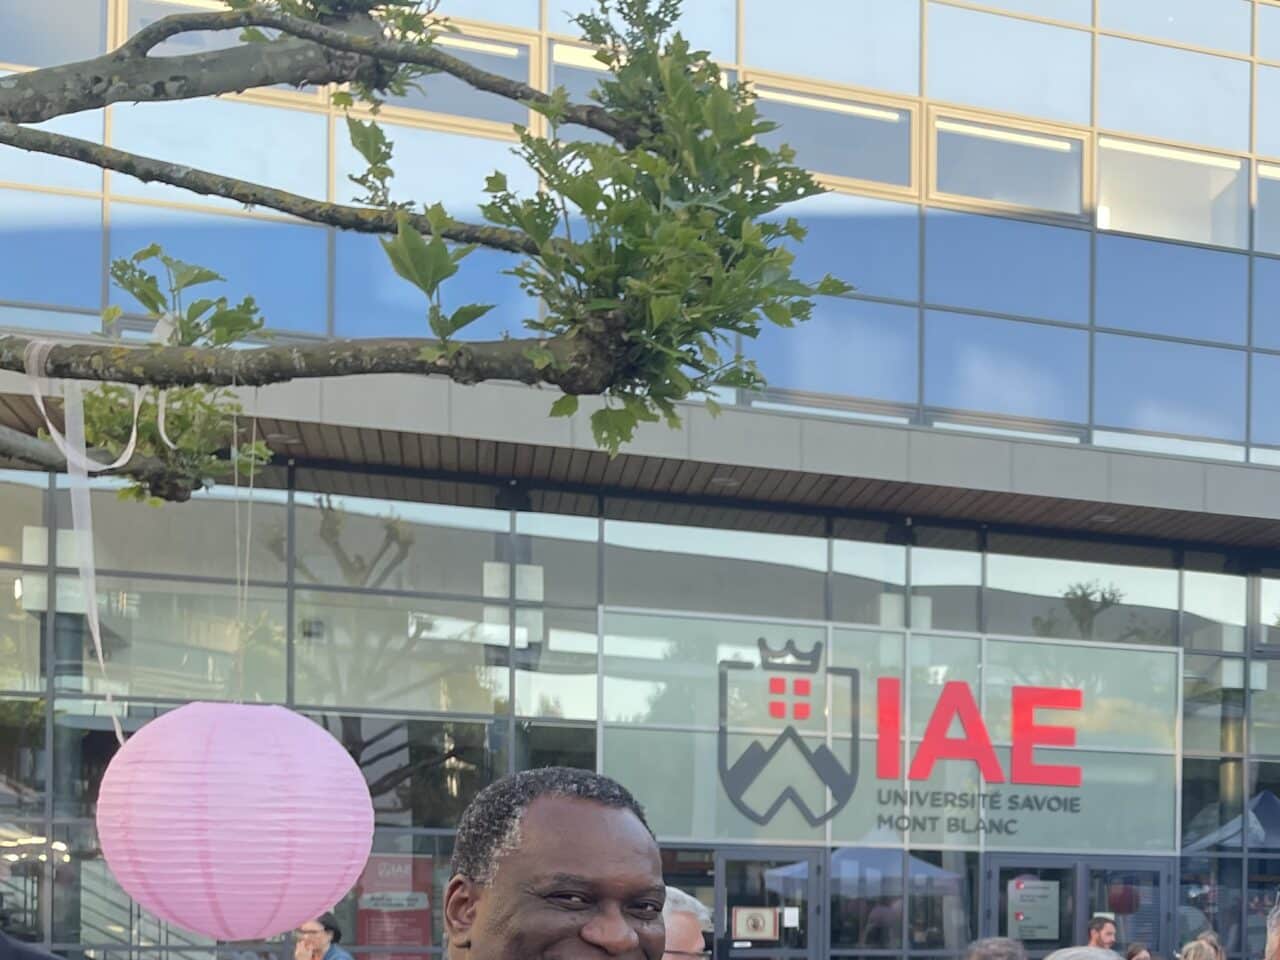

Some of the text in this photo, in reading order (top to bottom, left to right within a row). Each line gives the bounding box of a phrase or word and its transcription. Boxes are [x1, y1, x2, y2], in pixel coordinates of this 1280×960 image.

[876, 677, 1082, 787] IAE
[877, 788, 1081, 813] UNIVERSITÉ SAVOIE
[877, 814, 1018, 835] MONT BLANC
